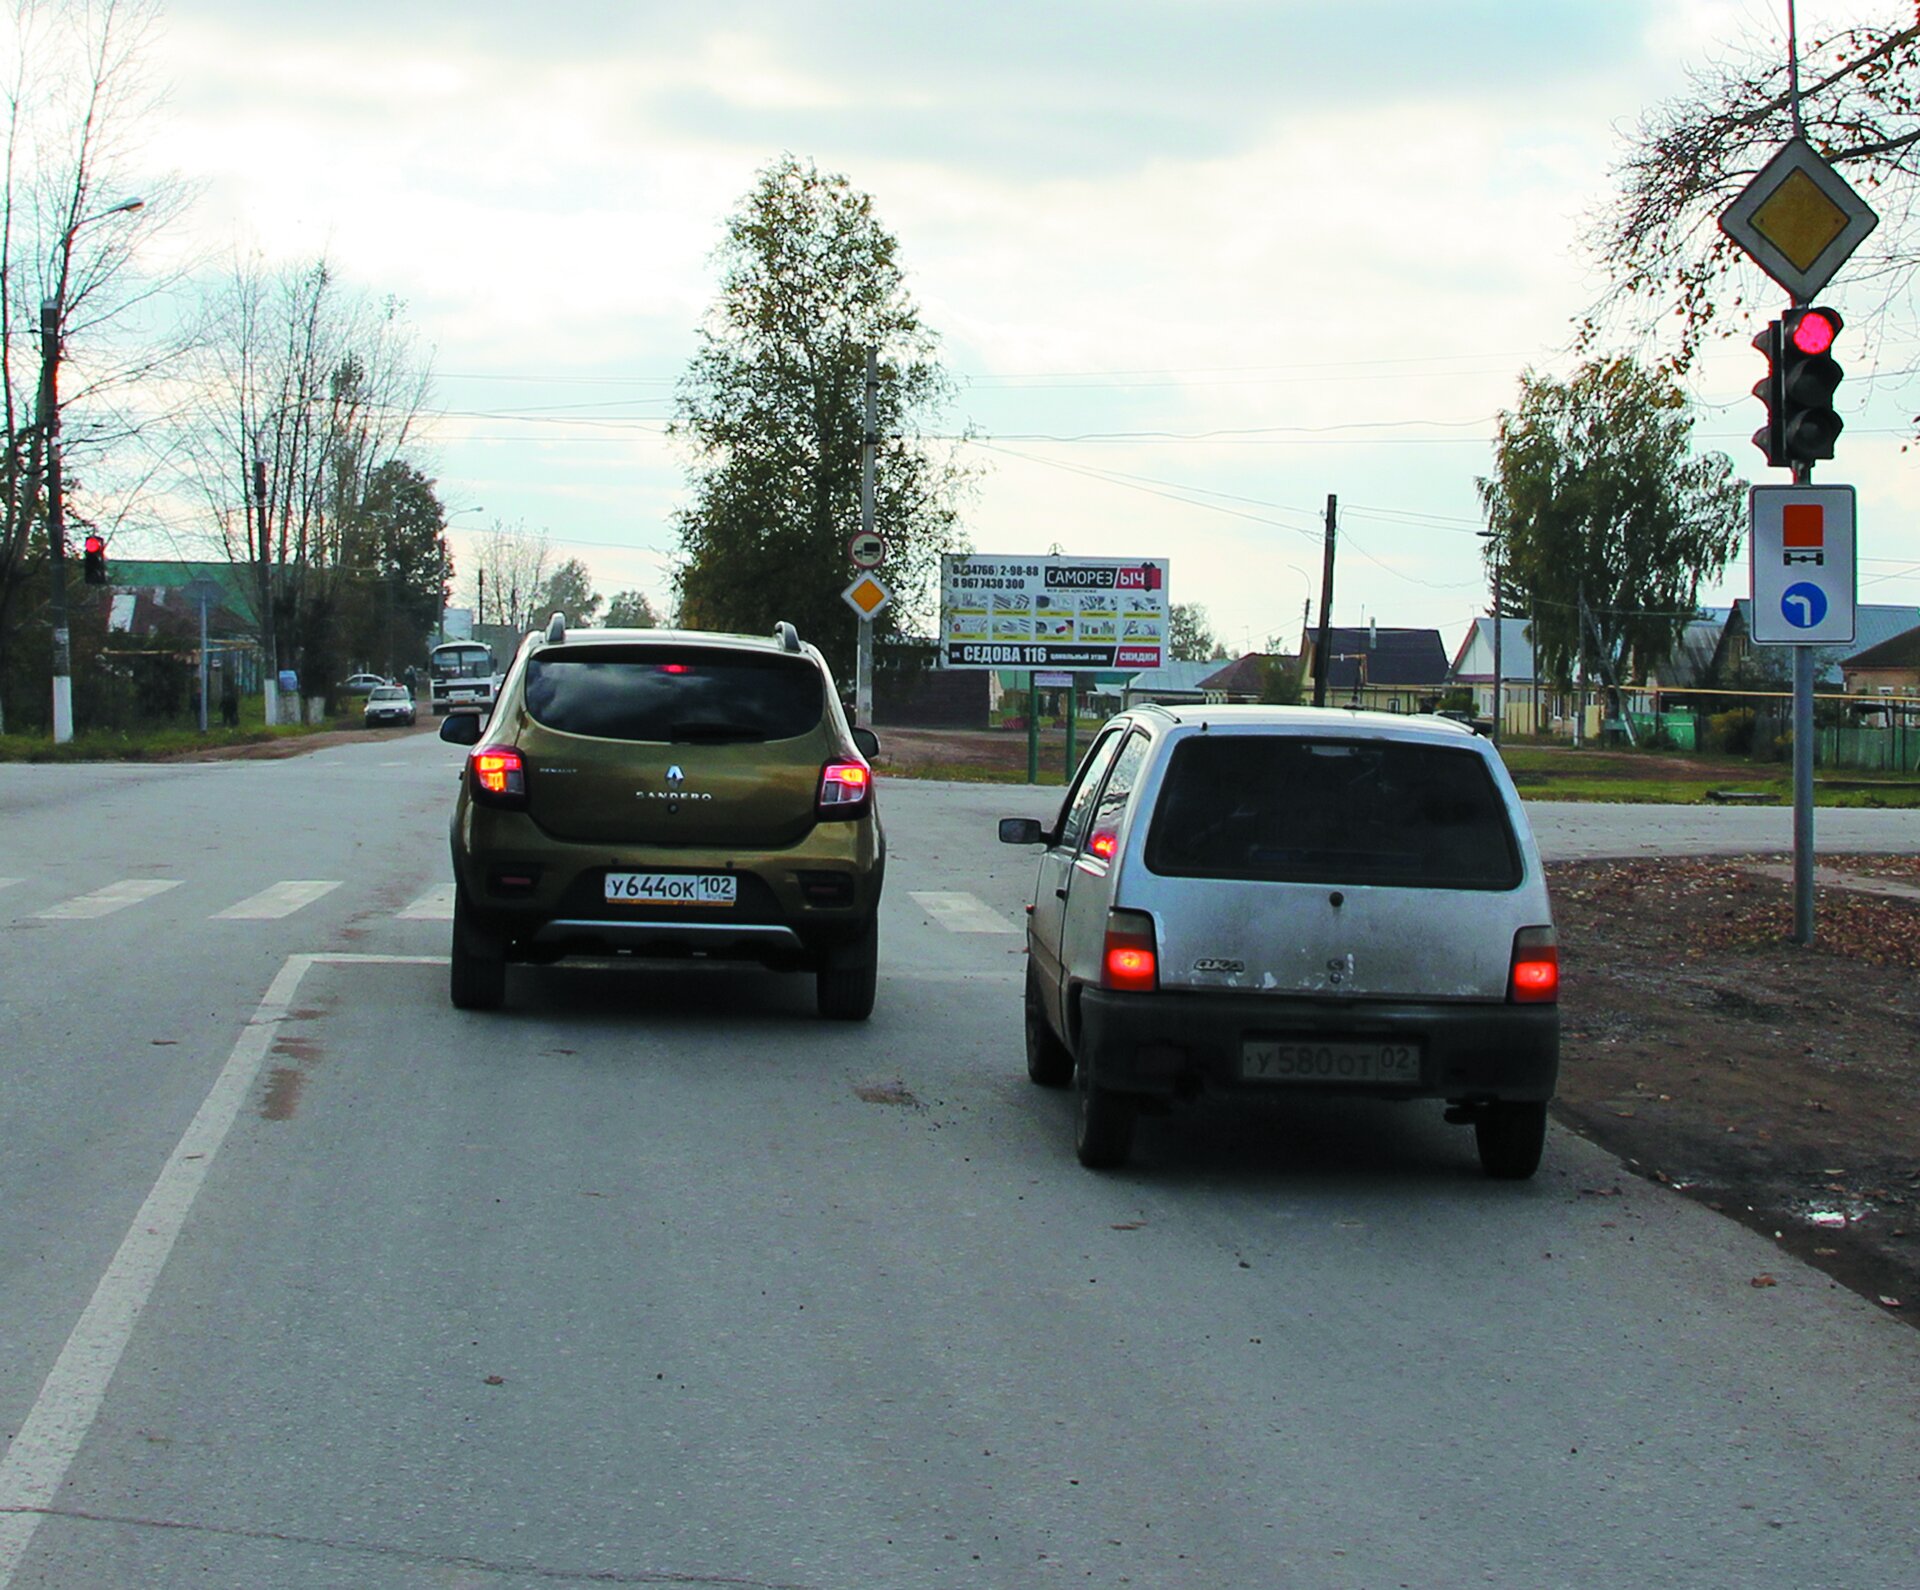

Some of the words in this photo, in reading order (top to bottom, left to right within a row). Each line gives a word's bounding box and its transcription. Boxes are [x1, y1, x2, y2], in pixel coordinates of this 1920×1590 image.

[953, 564, 960, 575] 8
[961, 565, 998, 576] 34766)
[1000, 565, 1039, 576] 2-98-88
[952, 577, 959, 588] 8
[961, 578, 979, 589] 967
[981, 578, 1004, 590] 7430
[1005, 579, 1025, 590] 300
[1046, 570, 1114, 586] САМОРЕЗ
[963, 645, 1021, 663] СЕДОВА
[1023, 647, 1047, 663] 116
[636, 791, 712, 801] SANDERO
